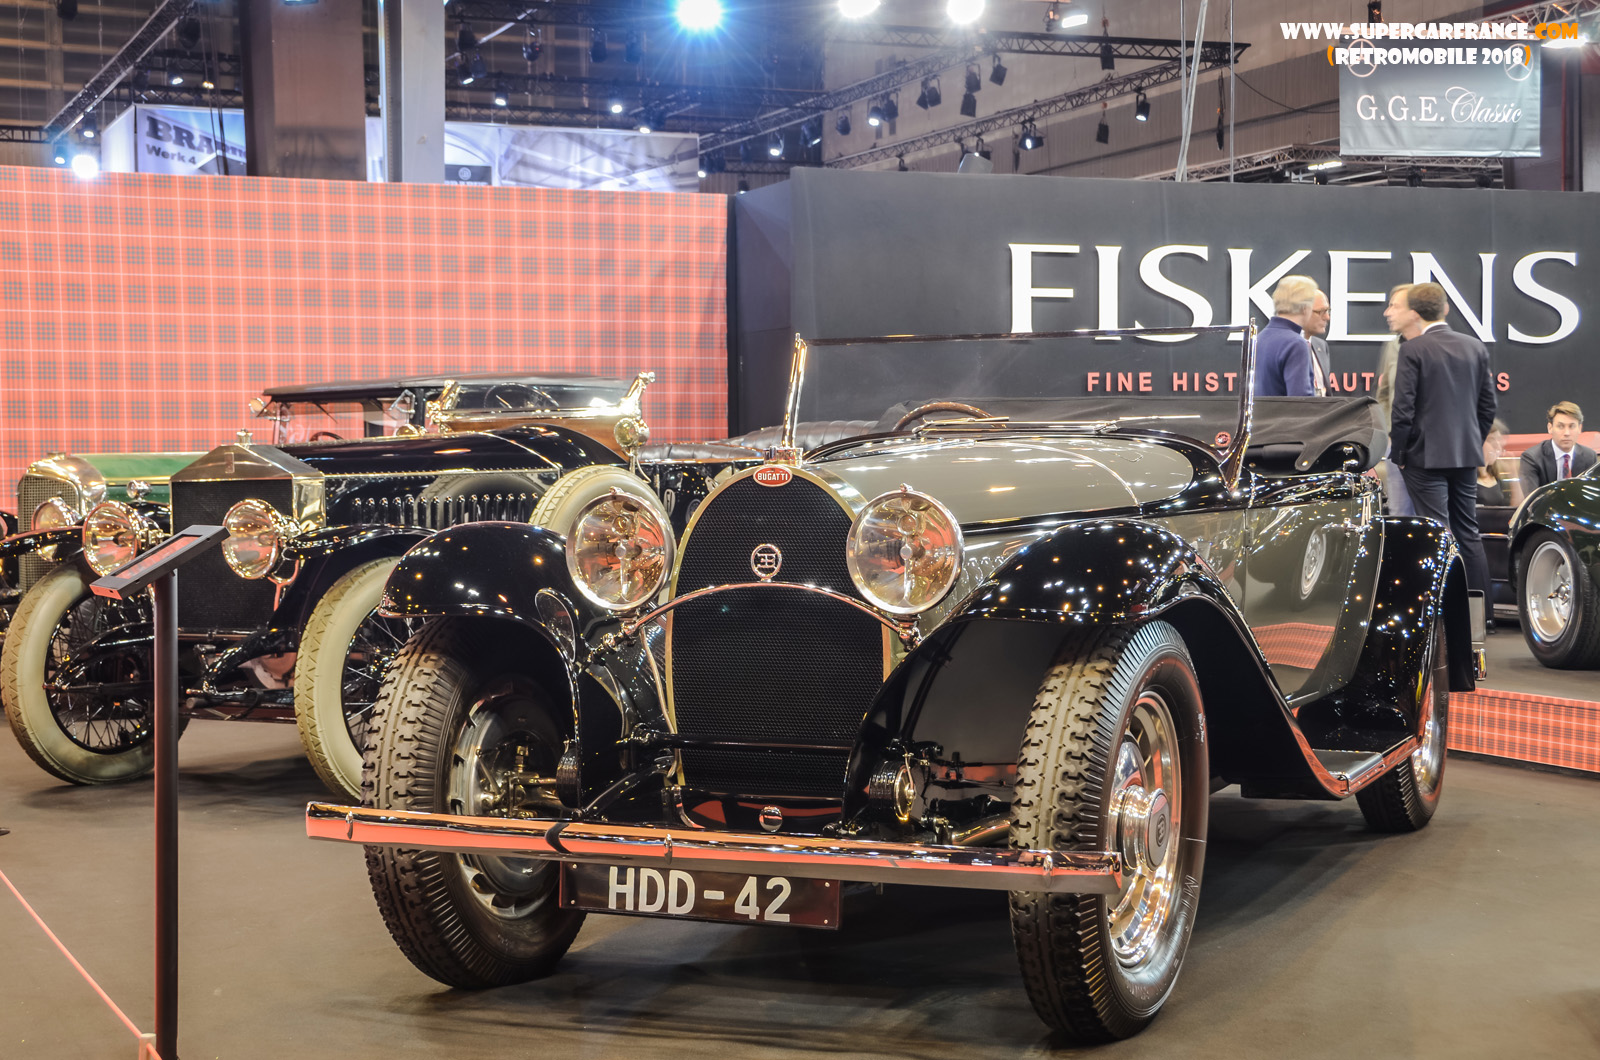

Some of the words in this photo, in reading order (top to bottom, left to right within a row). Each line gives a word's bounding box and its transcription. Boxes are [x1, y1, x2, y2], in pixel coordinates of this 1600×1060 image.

[1356, 94, 1445, 122] G.G.E.
[1445, 86, 1523, 123] Classic
[146, 143, 186, 163] Werk
[188, 155, 197, 166] 4
[1008, 243, 1581, 344] FISKENS
[1087, 371, 1153, 392] FINE
[757, 472, 788, 481] BUGATTI
